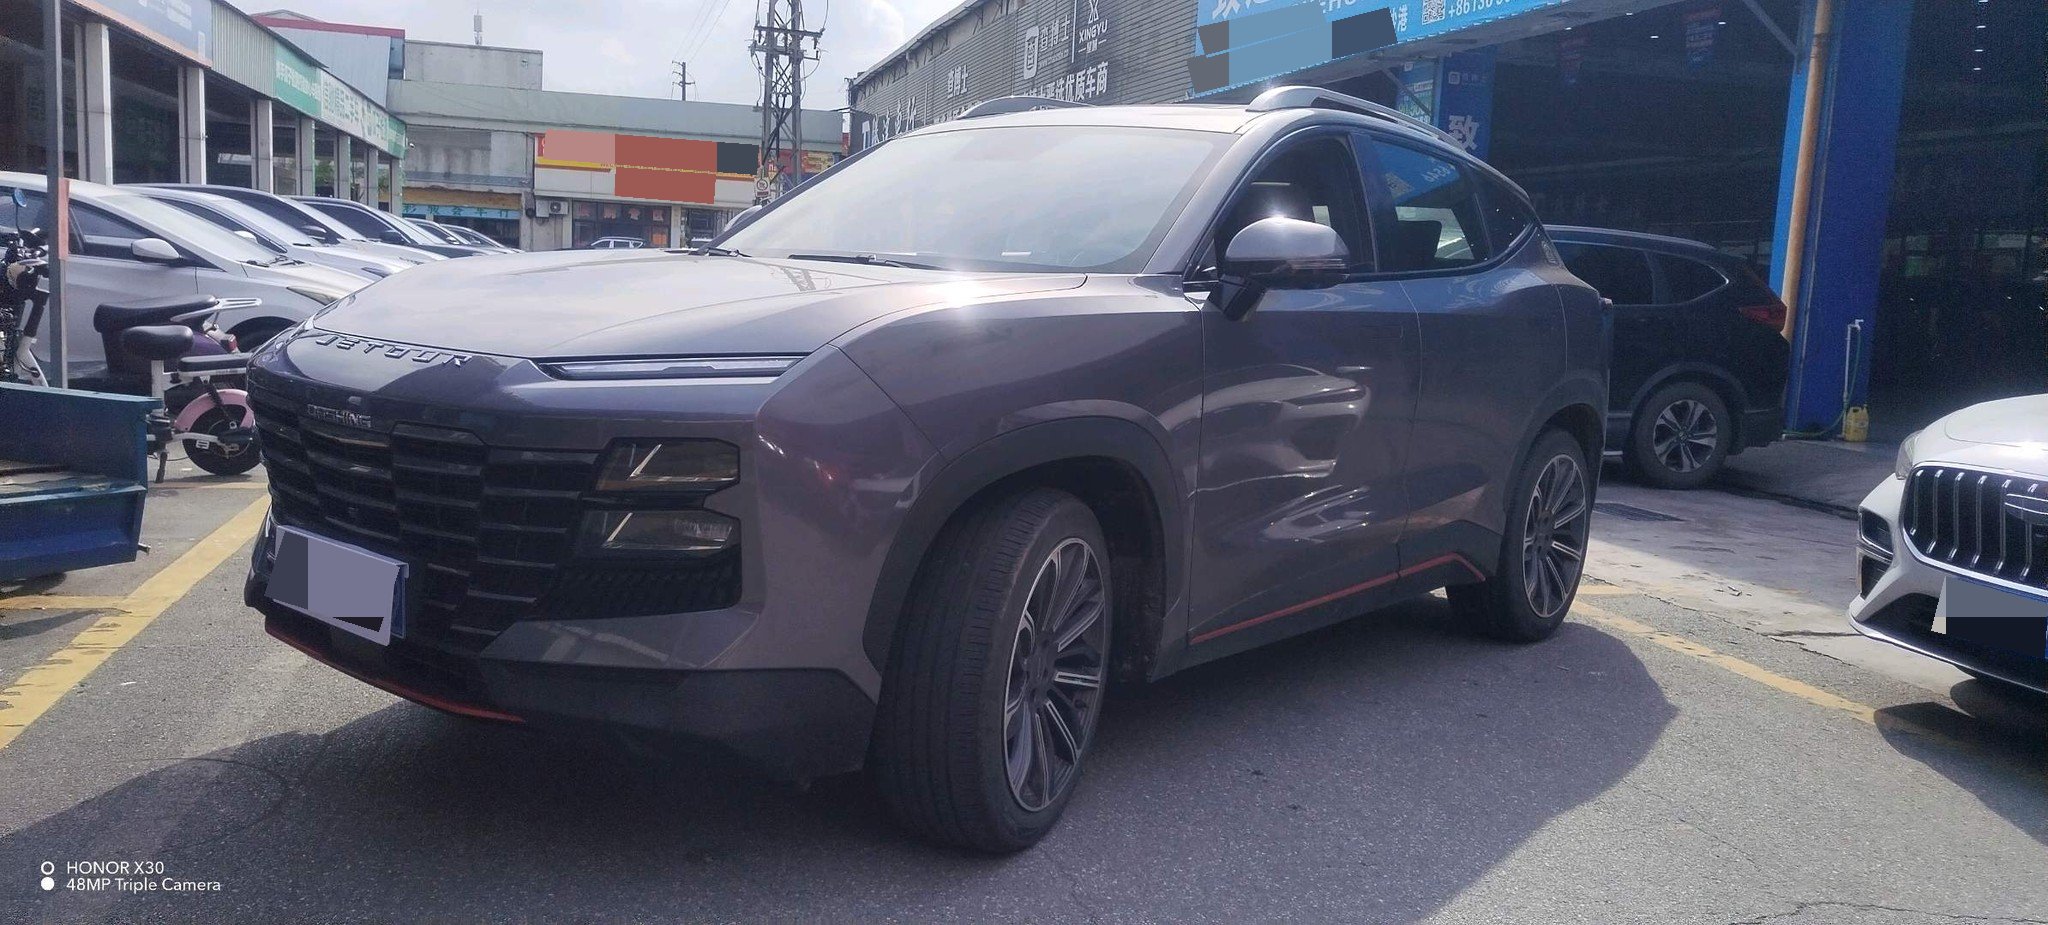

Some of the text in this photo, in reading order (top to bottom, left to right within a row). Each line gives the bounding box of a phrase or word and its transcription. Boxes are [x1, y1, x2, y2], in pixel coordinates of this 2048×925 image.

[1040, 14, 1071, 52] 查博士
[1079, 19, 1108, 44] XINGYU
[1448, 114, 1480, 150] 致
[315, 334, 474, 369] JETOUR
[306, 403, 372, 429] DASHING
